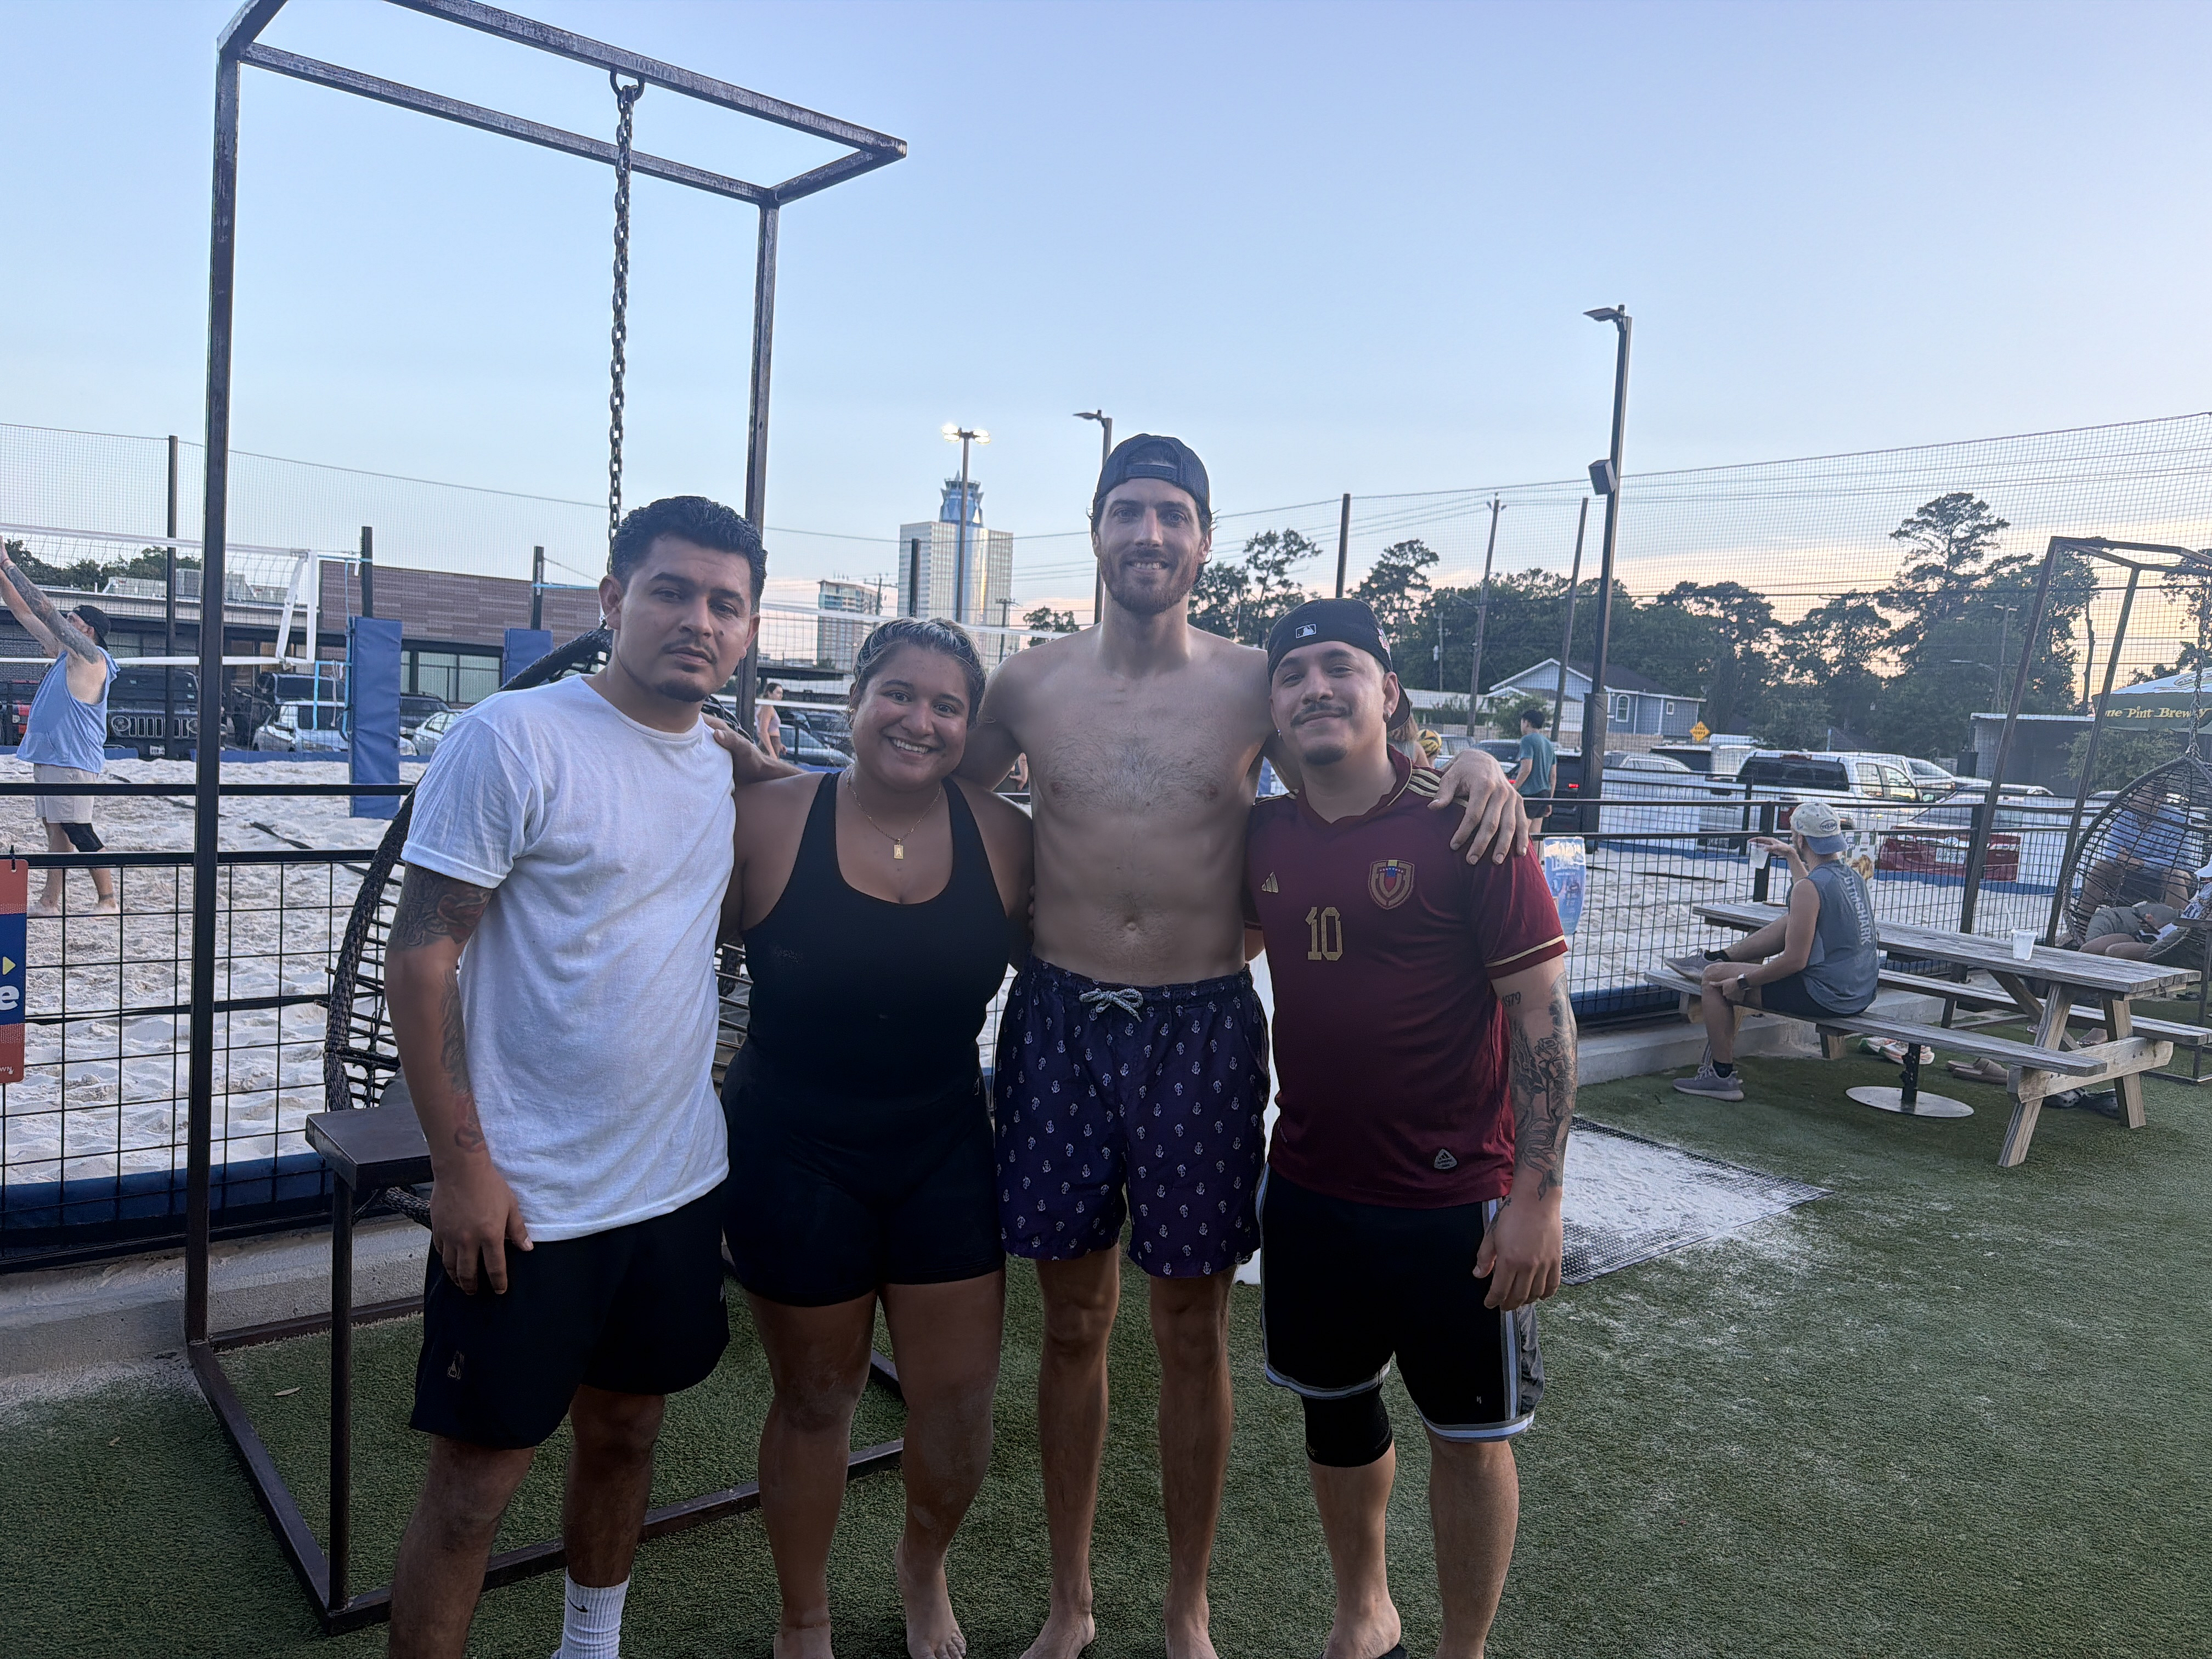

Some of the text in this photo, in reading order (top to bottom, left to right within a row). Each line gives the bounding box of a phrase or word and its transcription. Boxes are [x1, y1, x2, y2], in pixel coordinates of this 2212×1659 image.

[2124, 706, 2154, 718] Pint
[2154, 708, 2212, 718] Brewy
[896, 848, 902, 856] A
[1305, 907, 1342, 961] 10
[1502, 991, 1521, 1007] 1979
